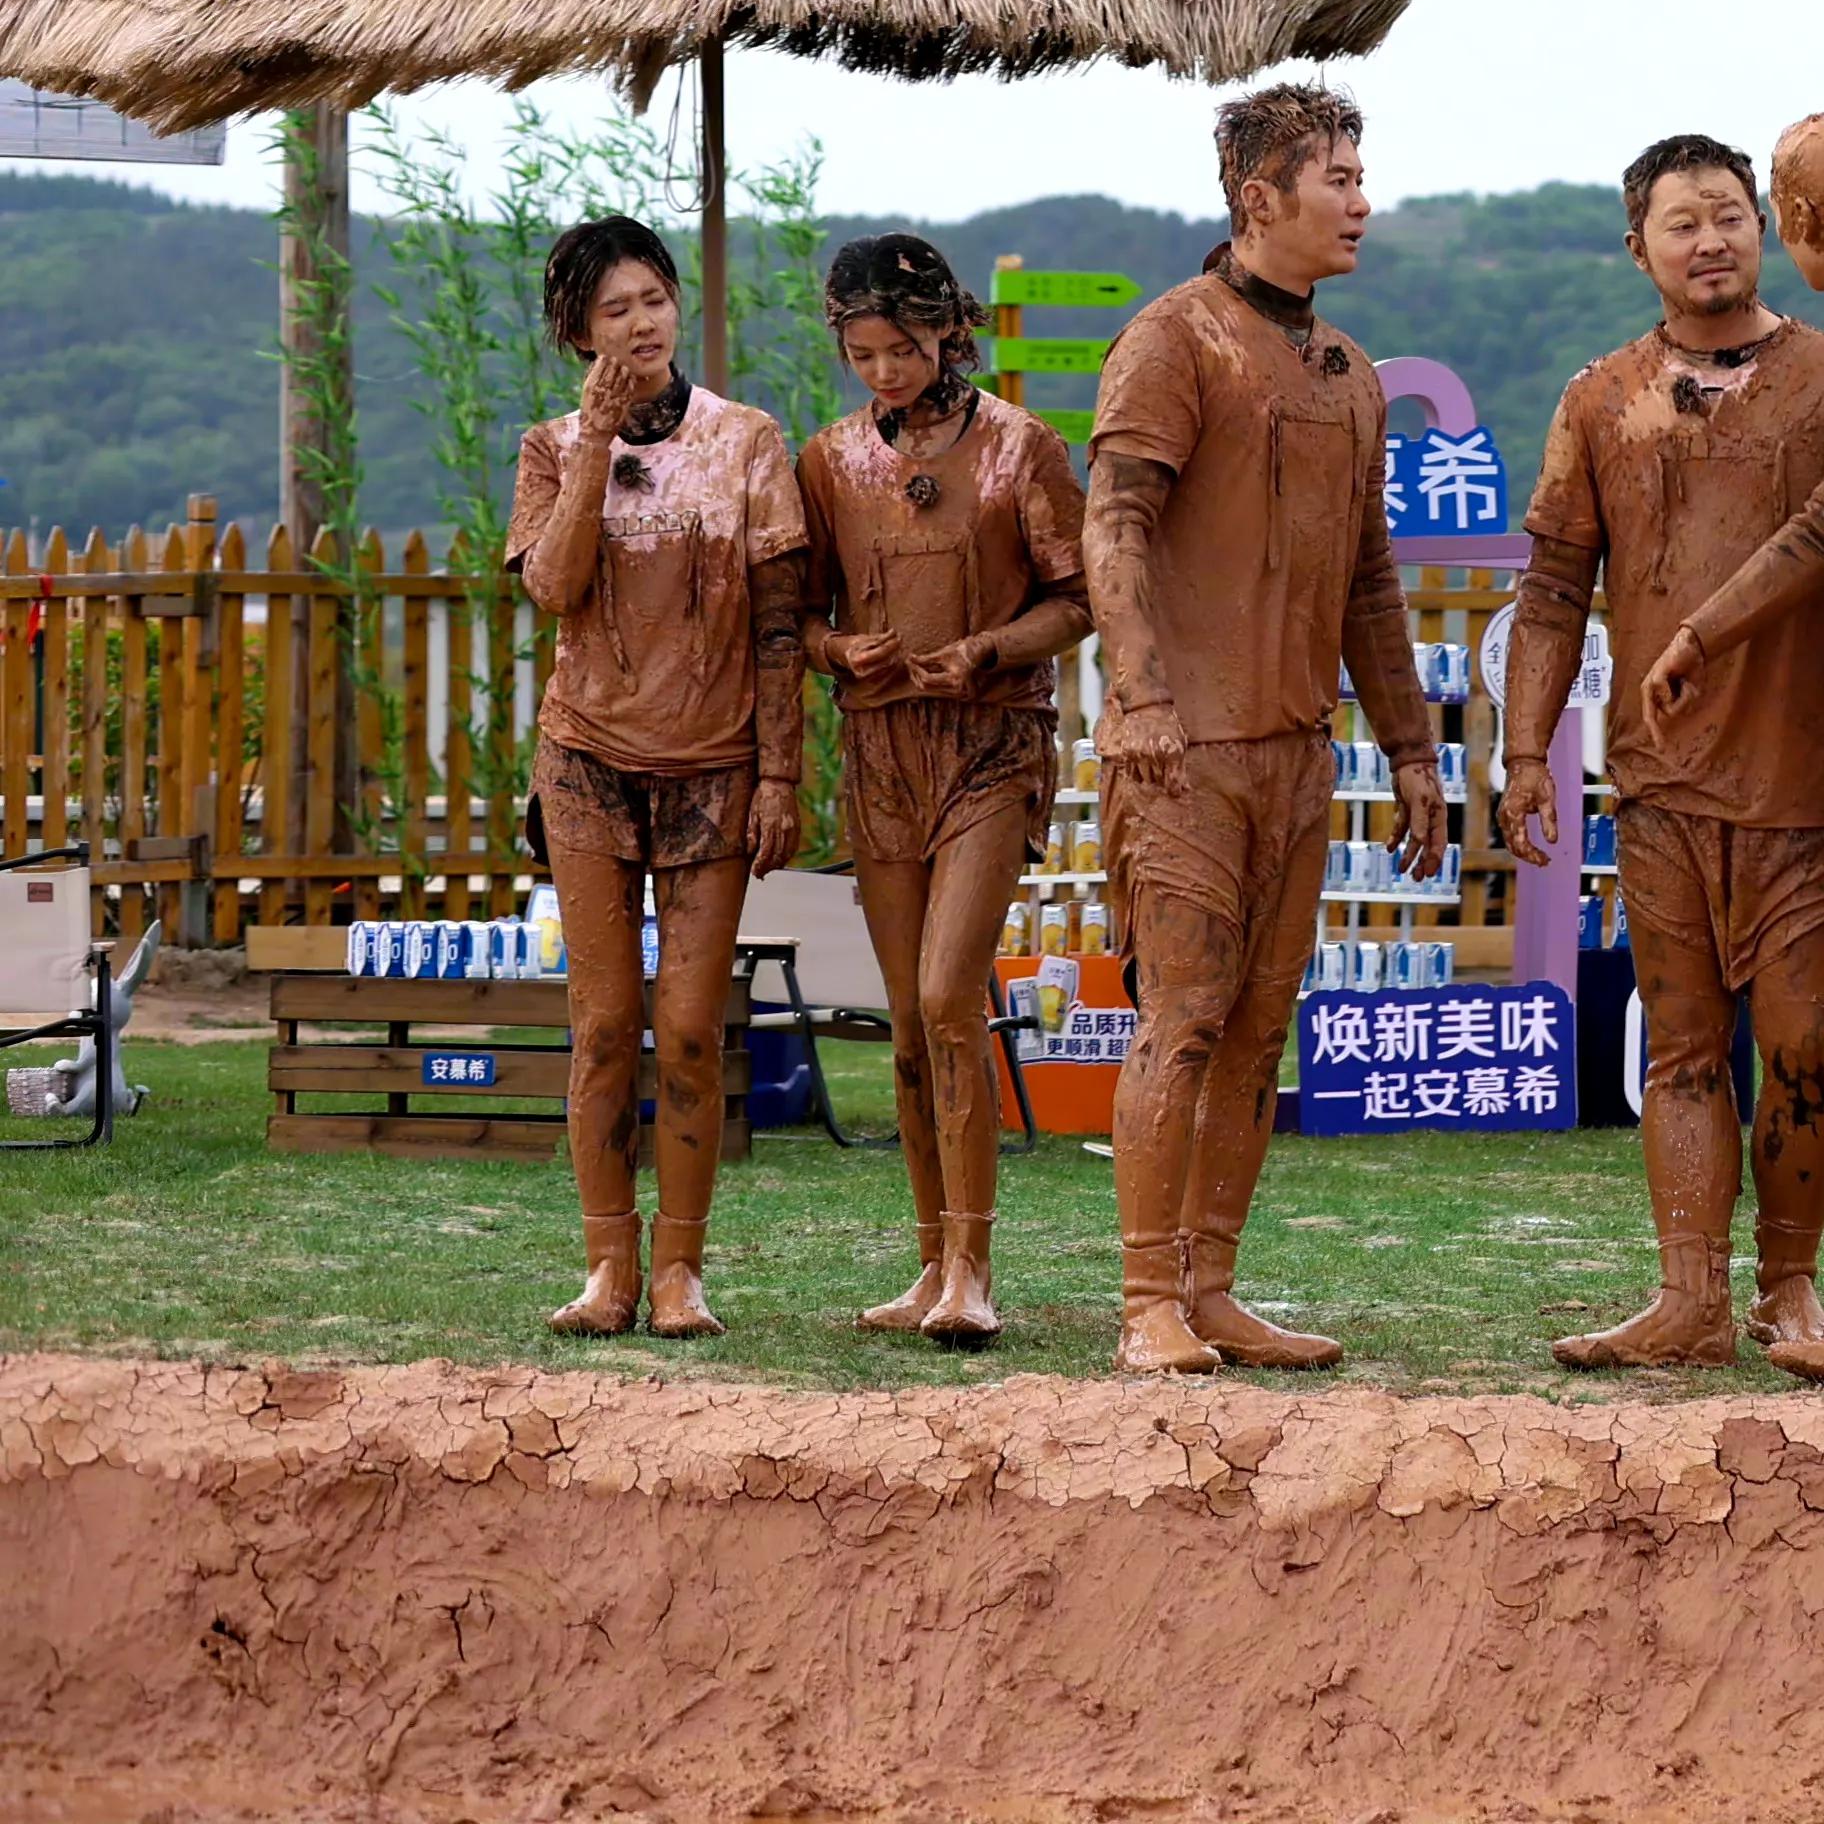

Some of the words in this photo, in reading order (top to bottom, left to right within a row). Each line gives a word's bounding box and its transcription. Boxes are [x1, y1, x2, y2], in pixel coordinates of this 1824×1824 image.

[1047, 1037, 1101, 1057] 更顺滑
[1311, 994, 1560, 1065] 焕新美味
[431, 1057, 487, 1082] 安慕希
[1312, 1064, 1561, 1121] 一起安慕希
